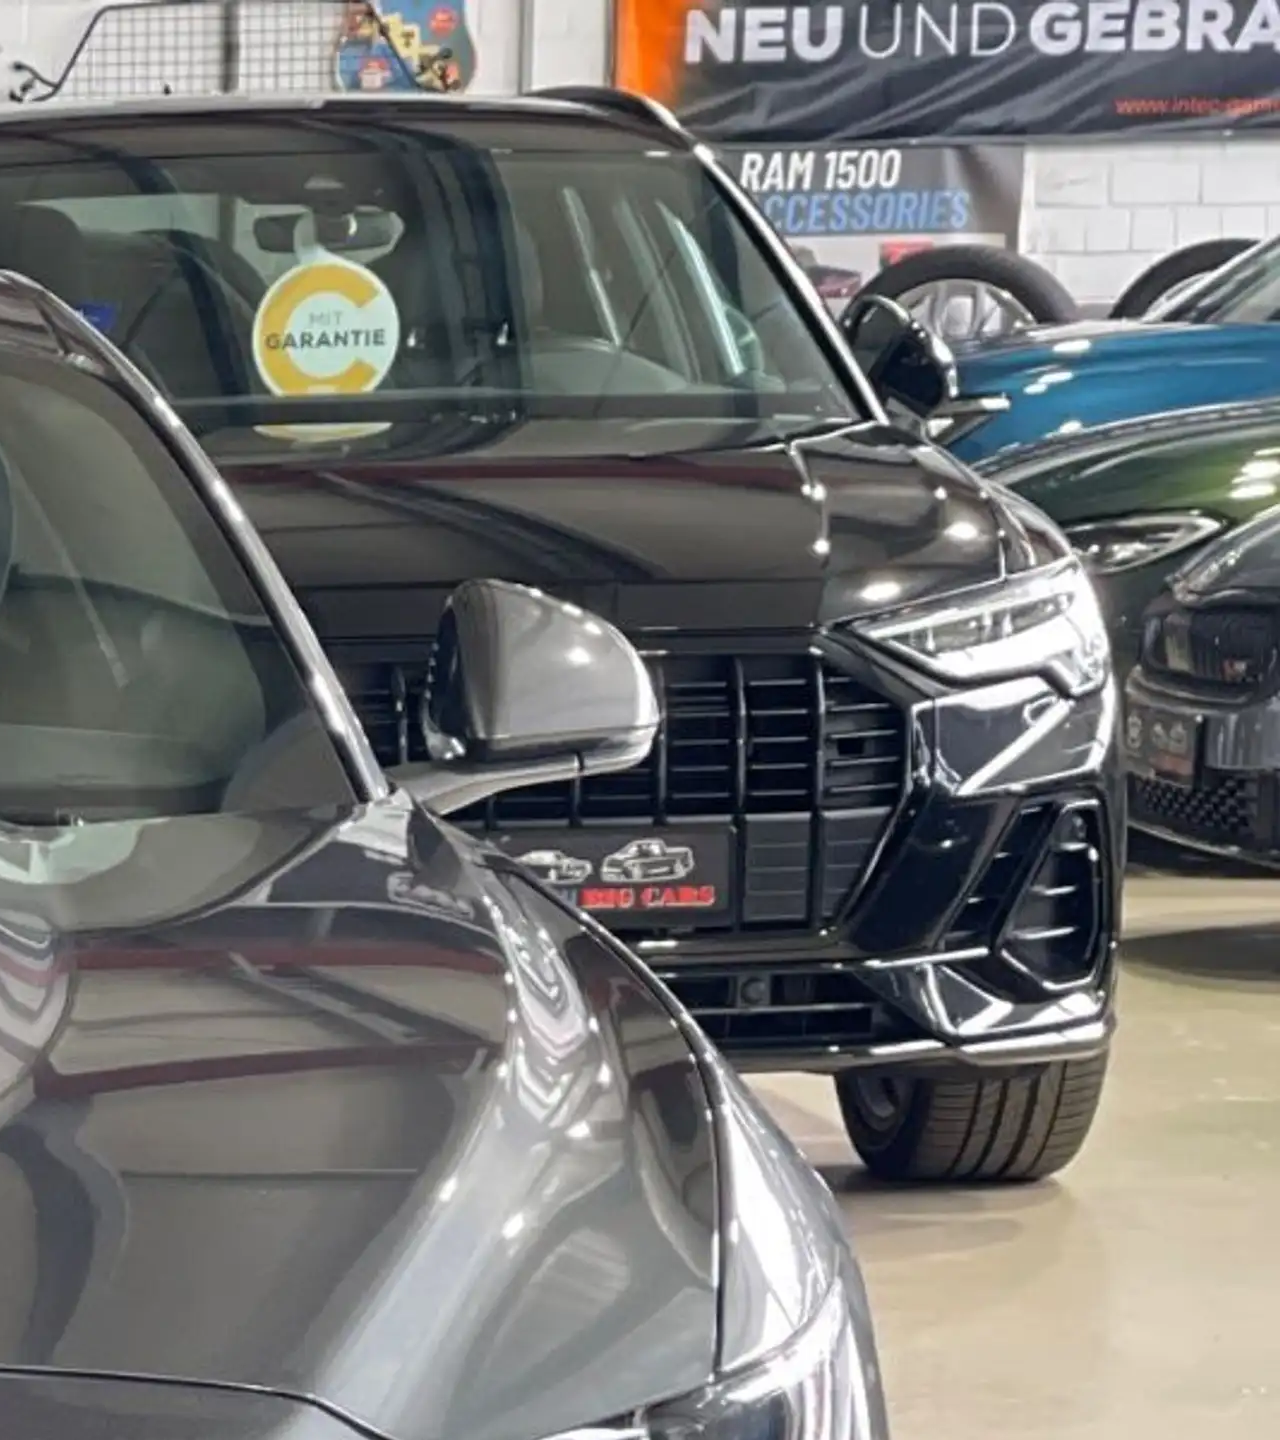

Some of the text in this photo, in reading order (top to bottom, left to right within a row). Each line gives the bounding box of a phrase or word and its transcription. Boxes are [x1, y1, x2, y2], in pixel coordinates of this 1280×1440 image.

[684, 5, 843, 62] NEU
[858, 2, 1016, 58] UND
[741, 149, 902, 192] RAM 1500
[762, 189, 970, 234] CCESSORIES
[265, 328, 386, 350] GARANTIE
